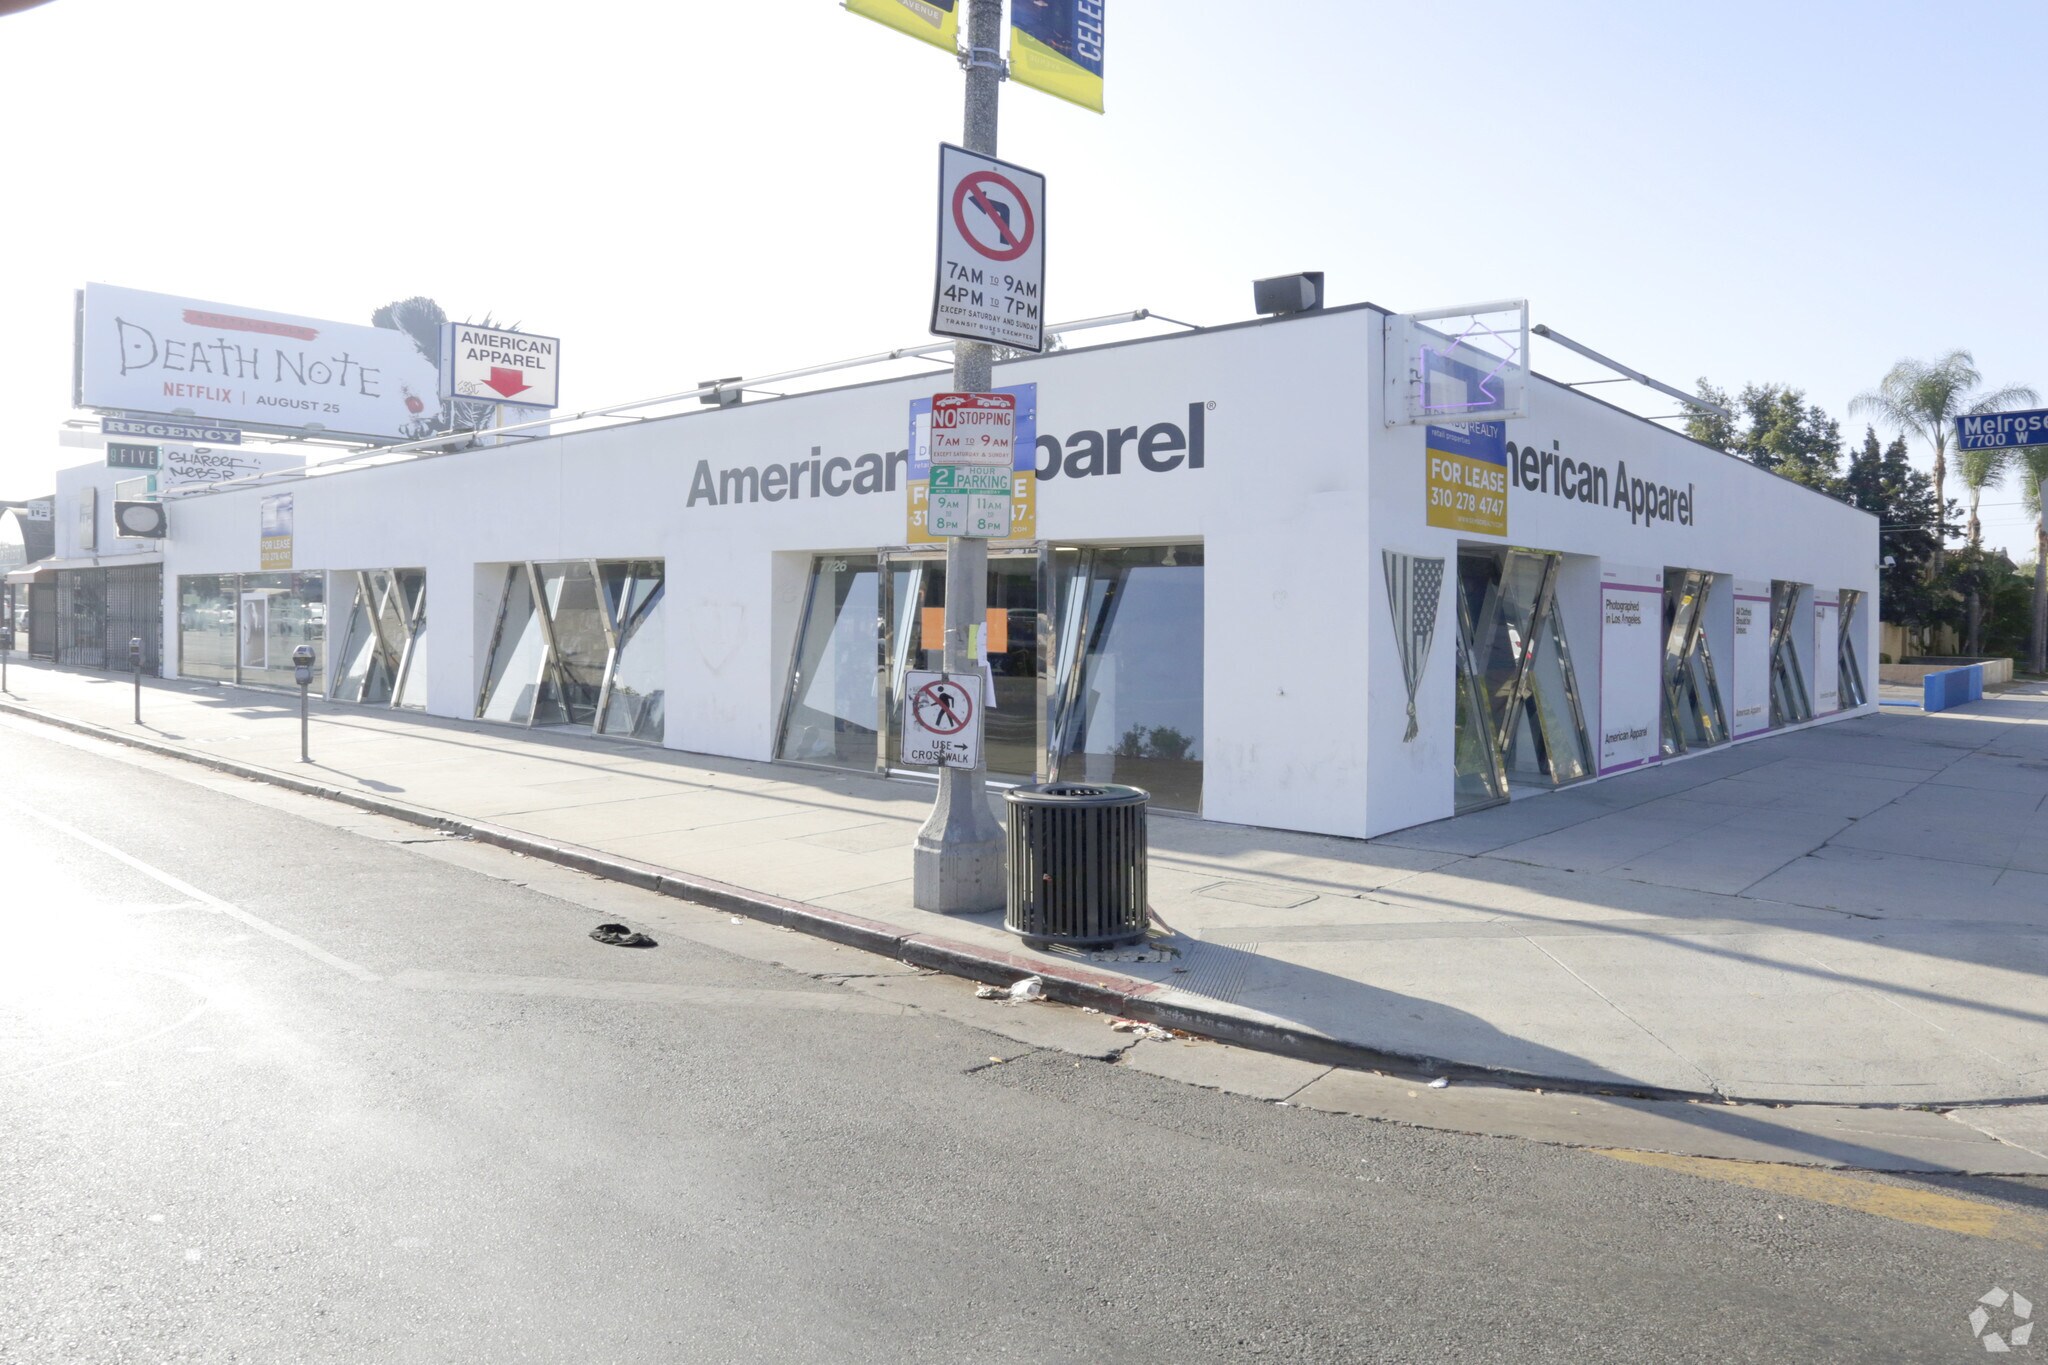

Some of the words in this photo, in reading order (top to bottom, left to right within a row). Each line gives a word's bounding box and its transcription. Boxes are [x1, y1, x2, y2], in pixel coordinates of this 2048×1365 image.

[1077, 0, 1102, 61] CELE
[944, 285, 983, 307] 4PM
[1004, 296, 1037, 320] 7PM
[940, 305, 967, 316] EXCEPT
[968, 310, 1000, 322] SATURDAY
[1003, 318, 1015, 327] AND
[1015, 320, 1038, 331] SUNDAY
[945, 318, 977, 328] TRANSIT
[979, 324, 1001, 333] BUSES
[1002, 329, 1033, 340] EXEMPTED
[461, 331, 552, 355] AMERICAN
[115, 316, 259, 380] DEATH
[275, 349, 381, 398] NOTE
[466, 348, 546, 370] APPAREL
[163, 382, 231, 403] NETFLIX
[256, 395, 319, 411] AUGUST
[323, 402, 340, 414] 25
[932, 408, 957, 428] NO
[959, 411, 1011, 426] STOPPING
[106, 420, 239, 442] REGENCY
[1469, 421, 1498, 438] REALTY
[1965, 433, 2006, 448] 7700
[2015, 431, 2029, 444] W
[1035, 402, 1205, 481] parel
[935, 468, 949, 486] 2
[969, 467, 996, 475] HOUR
[957, 475, 1008, 488] PARKING
[1431, 458, 1461, 484] FOR
[1464, 465, 1505, 494] LEASE
[1431, 487, 1452, 507] 310
[1456, 492, 1476, 512] 278
[1479, 496, 1504, 517] 4747
[1613, 460, 1693, 528] Apparel
[261, 541, 272, 550] FOR
[273, 539, 291, 549] LEASE
[1606, 599, 1639, 613] Photographed
[1606, 612, 1611, 624] in
[1612, 613, 1621, 624] Los
[931, 740, 952, 750] USE
[1605, 731, 1629, 744] American
[1630, 727, 1648, 741] Apparel
